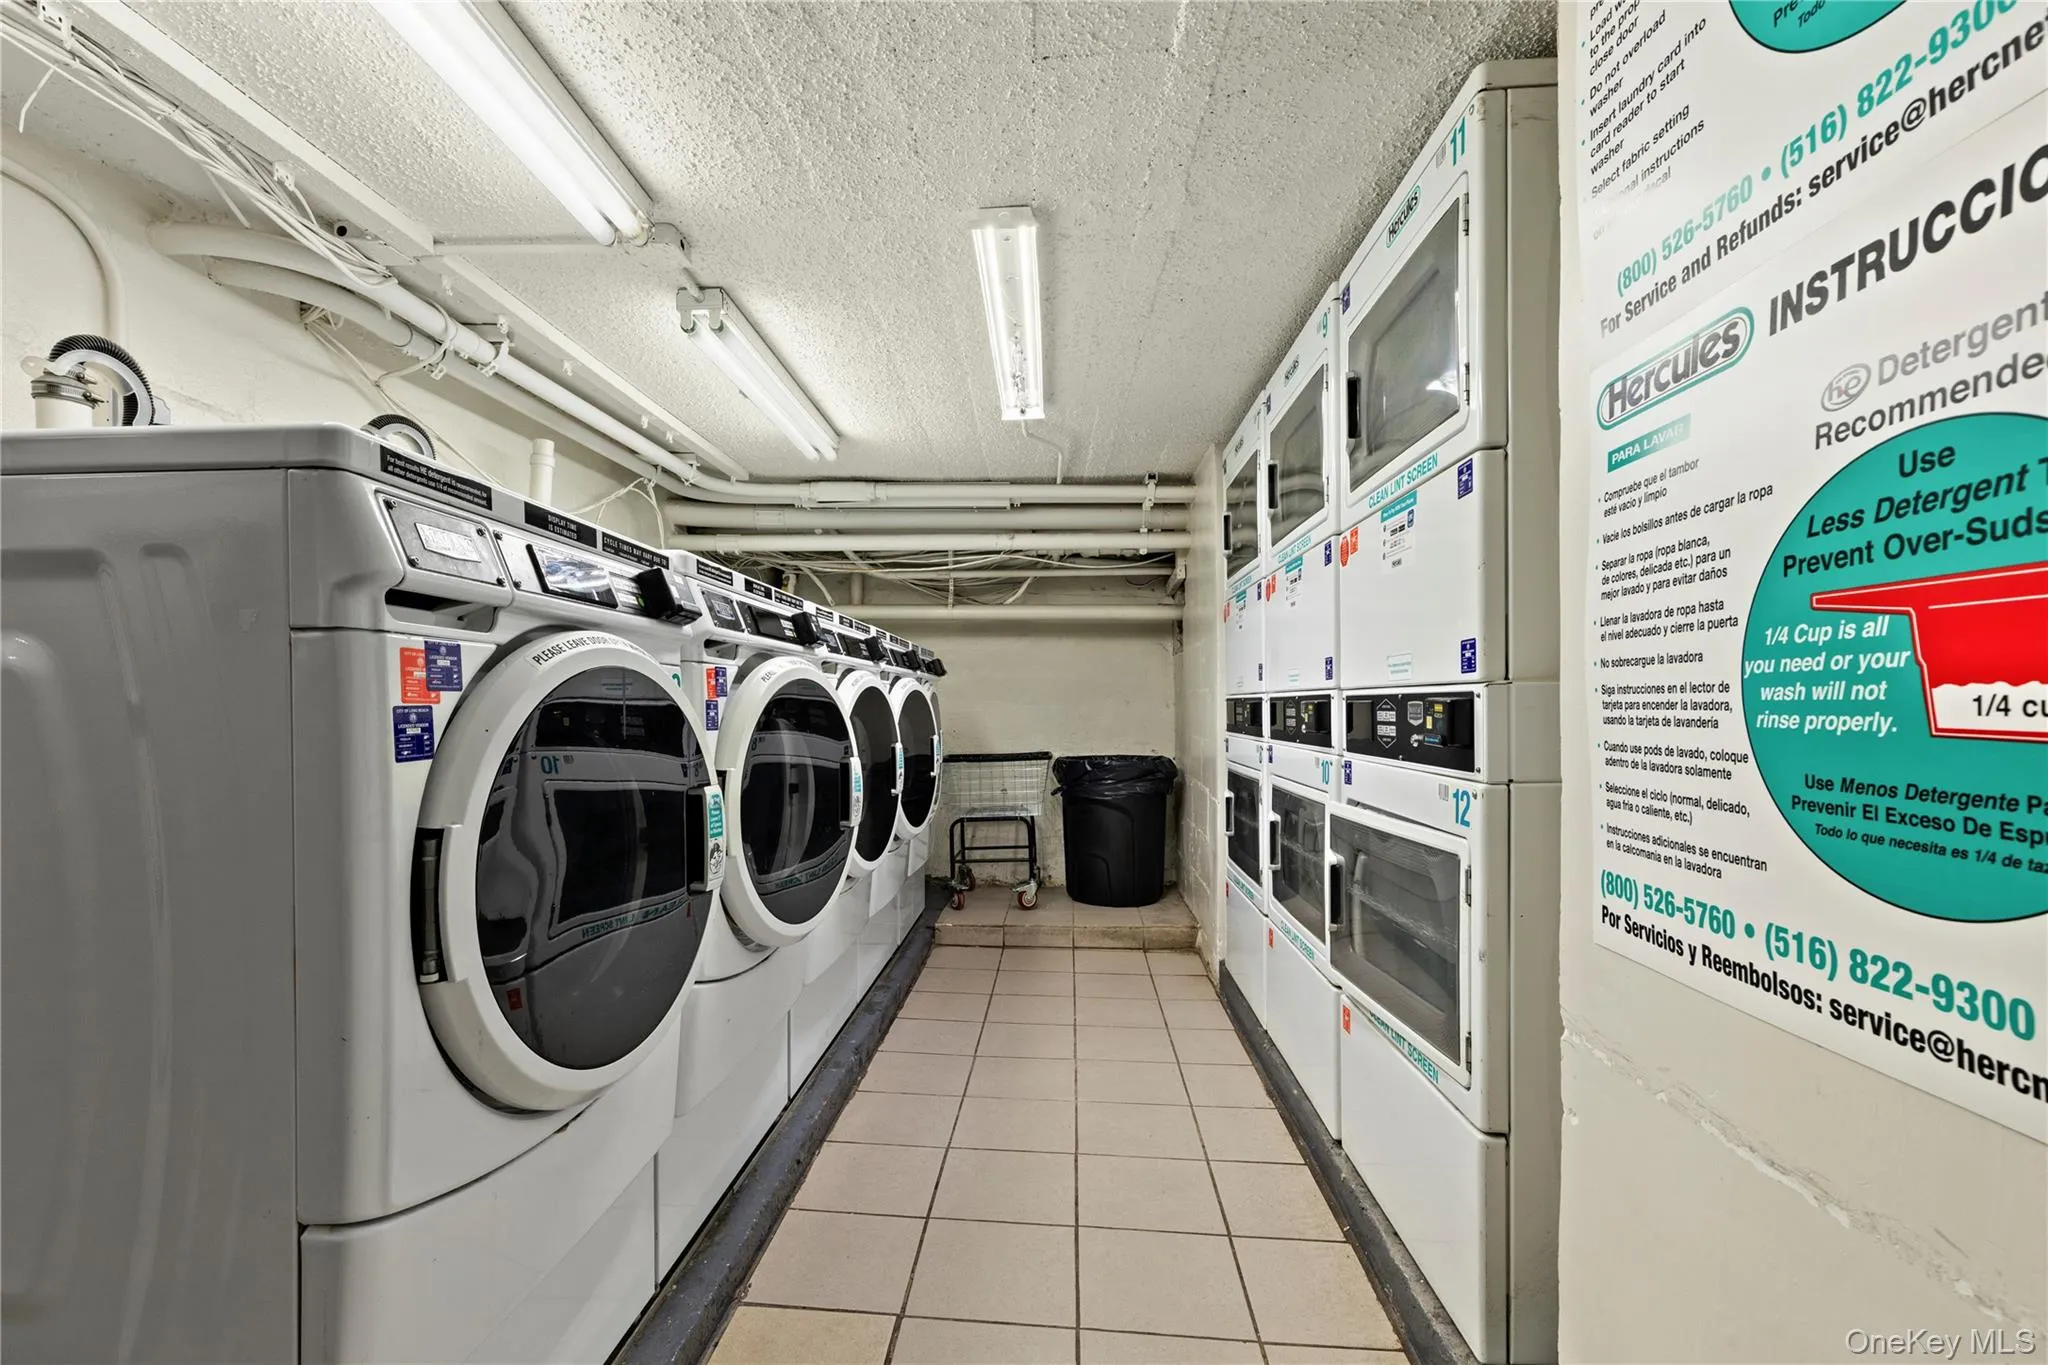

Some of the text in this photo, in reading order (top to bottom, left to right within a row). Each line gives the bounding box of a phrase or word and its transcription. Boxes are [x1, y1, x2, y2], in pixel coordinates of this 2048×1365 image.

[1590, 8, 1613, 42] Load
[1590, 45, 1614, 76] close
[1616, 16, 1640, 47] door
[1590, 9, 1666, 100] Do not overload
[1590, 18, 1706, 141] Insert laundry card into
[1590, 77, 1624, 116] washer
[1590, 59, 1685, 158] card reader start
[1451, 116, 1465, 167] 11
[1591, 139, 1625, 175] washer
[1592, 167, 1620, 199] Select
[1622, 141, 1650, 172] fabric
[1653, 104, 1690, 144] setting
[1641, 119, 1705, 181] instructions
[1600, 5, 2048, 339] For Service and Refunds: service@hercne
[1388, 190, 1419, 243] Hercules
[1617, 247, 1657, 297] (800)
[1662, 174, 1753, 261] 526-5760
[1781, 104, 1848, 179] (516)
[1608, 321, 1741, 420] Hercules
[1815, 351, 2048, 450] Recommende
[1611, 423, 1684, 465] PARA LAVAR
[1899, 446, 1956, 478] Use
[1369, 487, 1389, 509] CLEAN
[1391, 474, 1406, 496] LINT
[1407, 452, 1438, 485] SCREEN
[1604, 458, 1699, 503] Compruebe tambor
[1632, 484, 1774, 536] bolsillos antes cargar ropa
[1807, 507, 1865, 539] Less
[1874, 463, 2030, 525] Detergent
[548, 514, 577, 532] DISPLAY TIME
[548, 523, 578, 541] IS ESTIMATED
[1783, 506, 2048, 578] Prevent Over-Suds
[603, 536, 618, 549] CYCLE
[619, 542, 632, 554] TIMES
[1601, 535, 1710, 572] Separar (ropa blanca,
[1640, 551, 1717, 577] delicada para
[1621, 571, 1697, 597] lavado para evitar
[1600, 598, 1724, 628] Llenar lavadora ropa hasta
[1625, 615, 1739, 639] adecuado cierre puerta
[1764, 614, 1890, 648] 1/4 Cup is all
[532, 636, 590, 666] PLEASE LEAVE
[1611, 650, 1704, 669] sobrecargue lavadora
[1743, 650, 1912, 679] you need or your
[1602, 699, 1734, 714] tarjeta encender lavadora,
[1617, 680, 1730, 696] instrucciones lector de
[1760, 680, 1888, 702] wash will not
[1972, 693, 2012, 718] 1/4
[1603, 714, 1719, 729] usando tarjeta lavandería
[1756, 711, 1898, 738] rinse properly.
[1321, 759, 1330, 785] 10
[1603, 740, 1749, 766] Cuando pods lavado, coloque
[1605, 755, 1732, 781] adentro lavadora solamente
[1453, 787, 1471, 828] 12
[1605, 781, 1750, 818] Seleccione ciclo (normal, delicado,
[1804, 773, 2021, 813] Use Menos Detergente
[1641, 804, 1673, 822] caliente,
[1791, 795, 1993, 839] Prevenir El Exceso De
[1606, 822, 1768, 872] Instrucciones adicionales encuentran
[1815, 823, 2023, 870] Todo lo que necesita es 1/4 de
[1684, 857, 1723, 880] lavadora
[1600, 869, 2036, 1042] (800) 526-5760 (516) 822-9300
[1601, 905, 1621, 930] Por
[1624, 914, 1684, 958] Servicios
[1688, 943, 1698, 966] y
[1702, 944, 1823, 1014] Reembolsos:
[1391, 1028, 1439, 1084] LINT SCREEN
